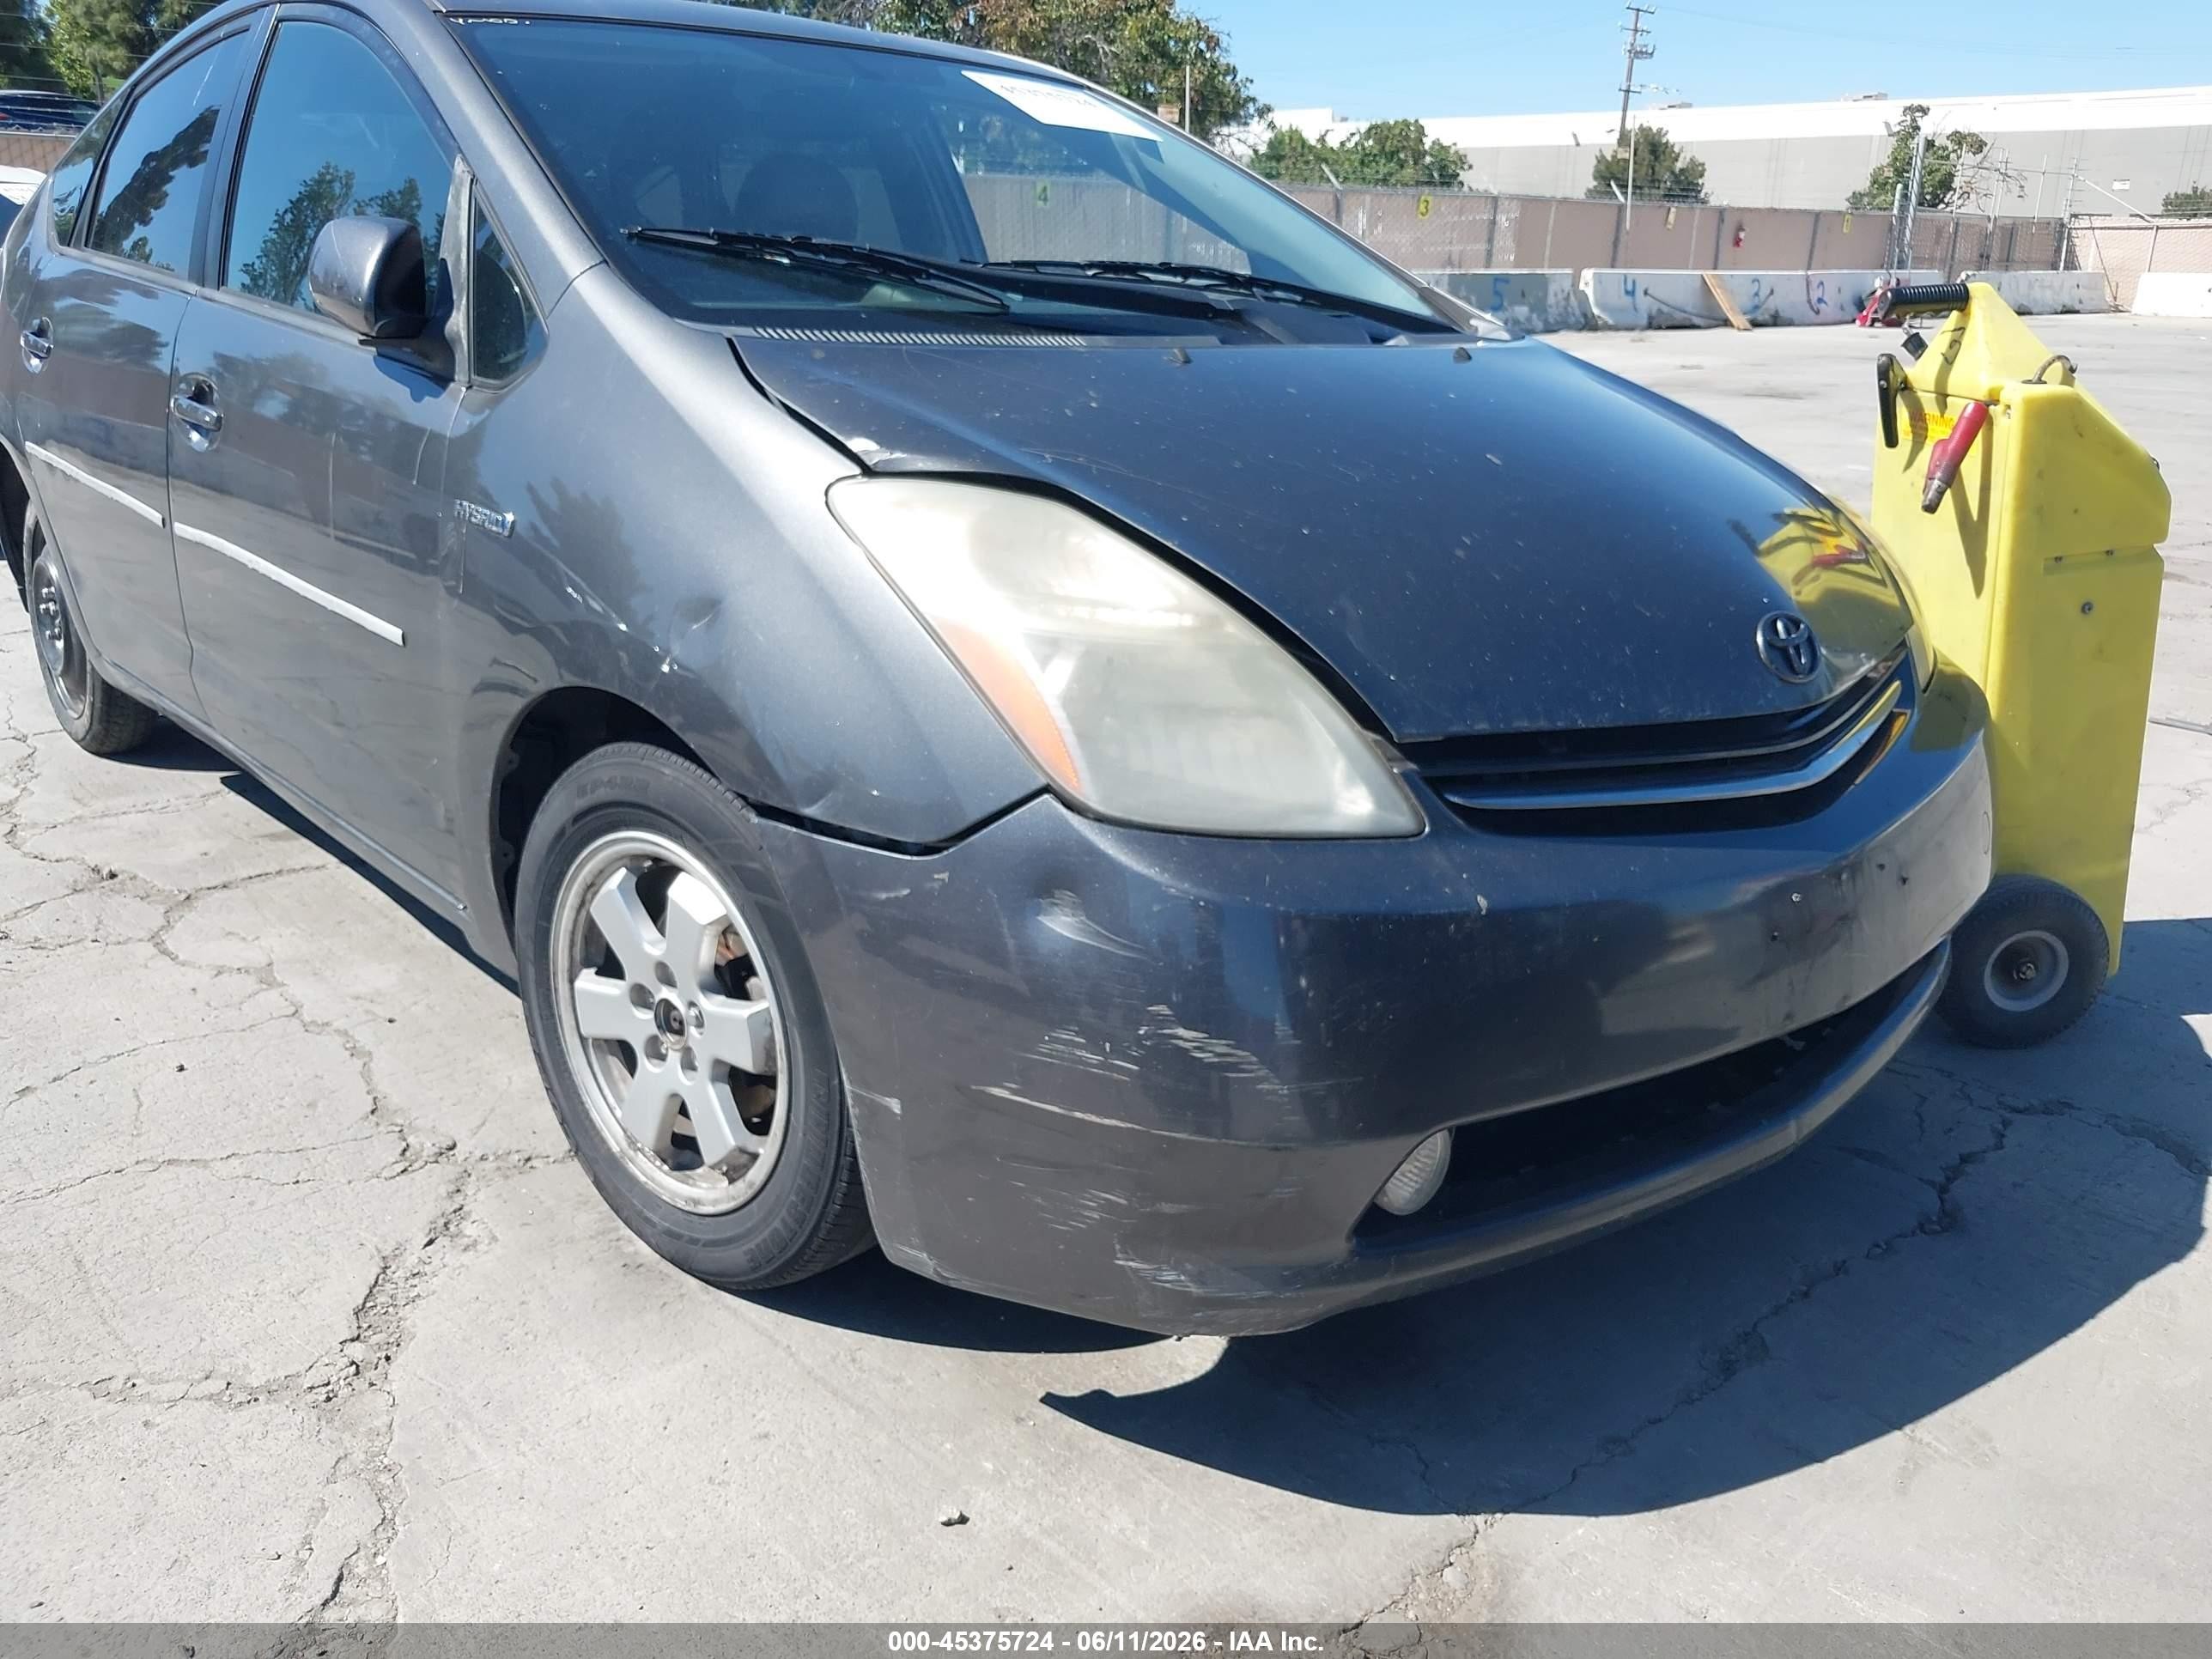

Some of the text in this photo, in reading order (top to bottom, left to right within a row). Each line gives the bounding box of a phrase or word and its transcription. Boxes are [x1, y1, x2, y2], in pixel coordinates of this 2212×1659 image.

[1419, 199, 1430, 216] 3
[1490, 276, 1510, 313] 5
[1623, 274, 1638, 313] 4
[1816, 280, 1827, 307] 2
[1910, 410, 1955, 428] WARNING
